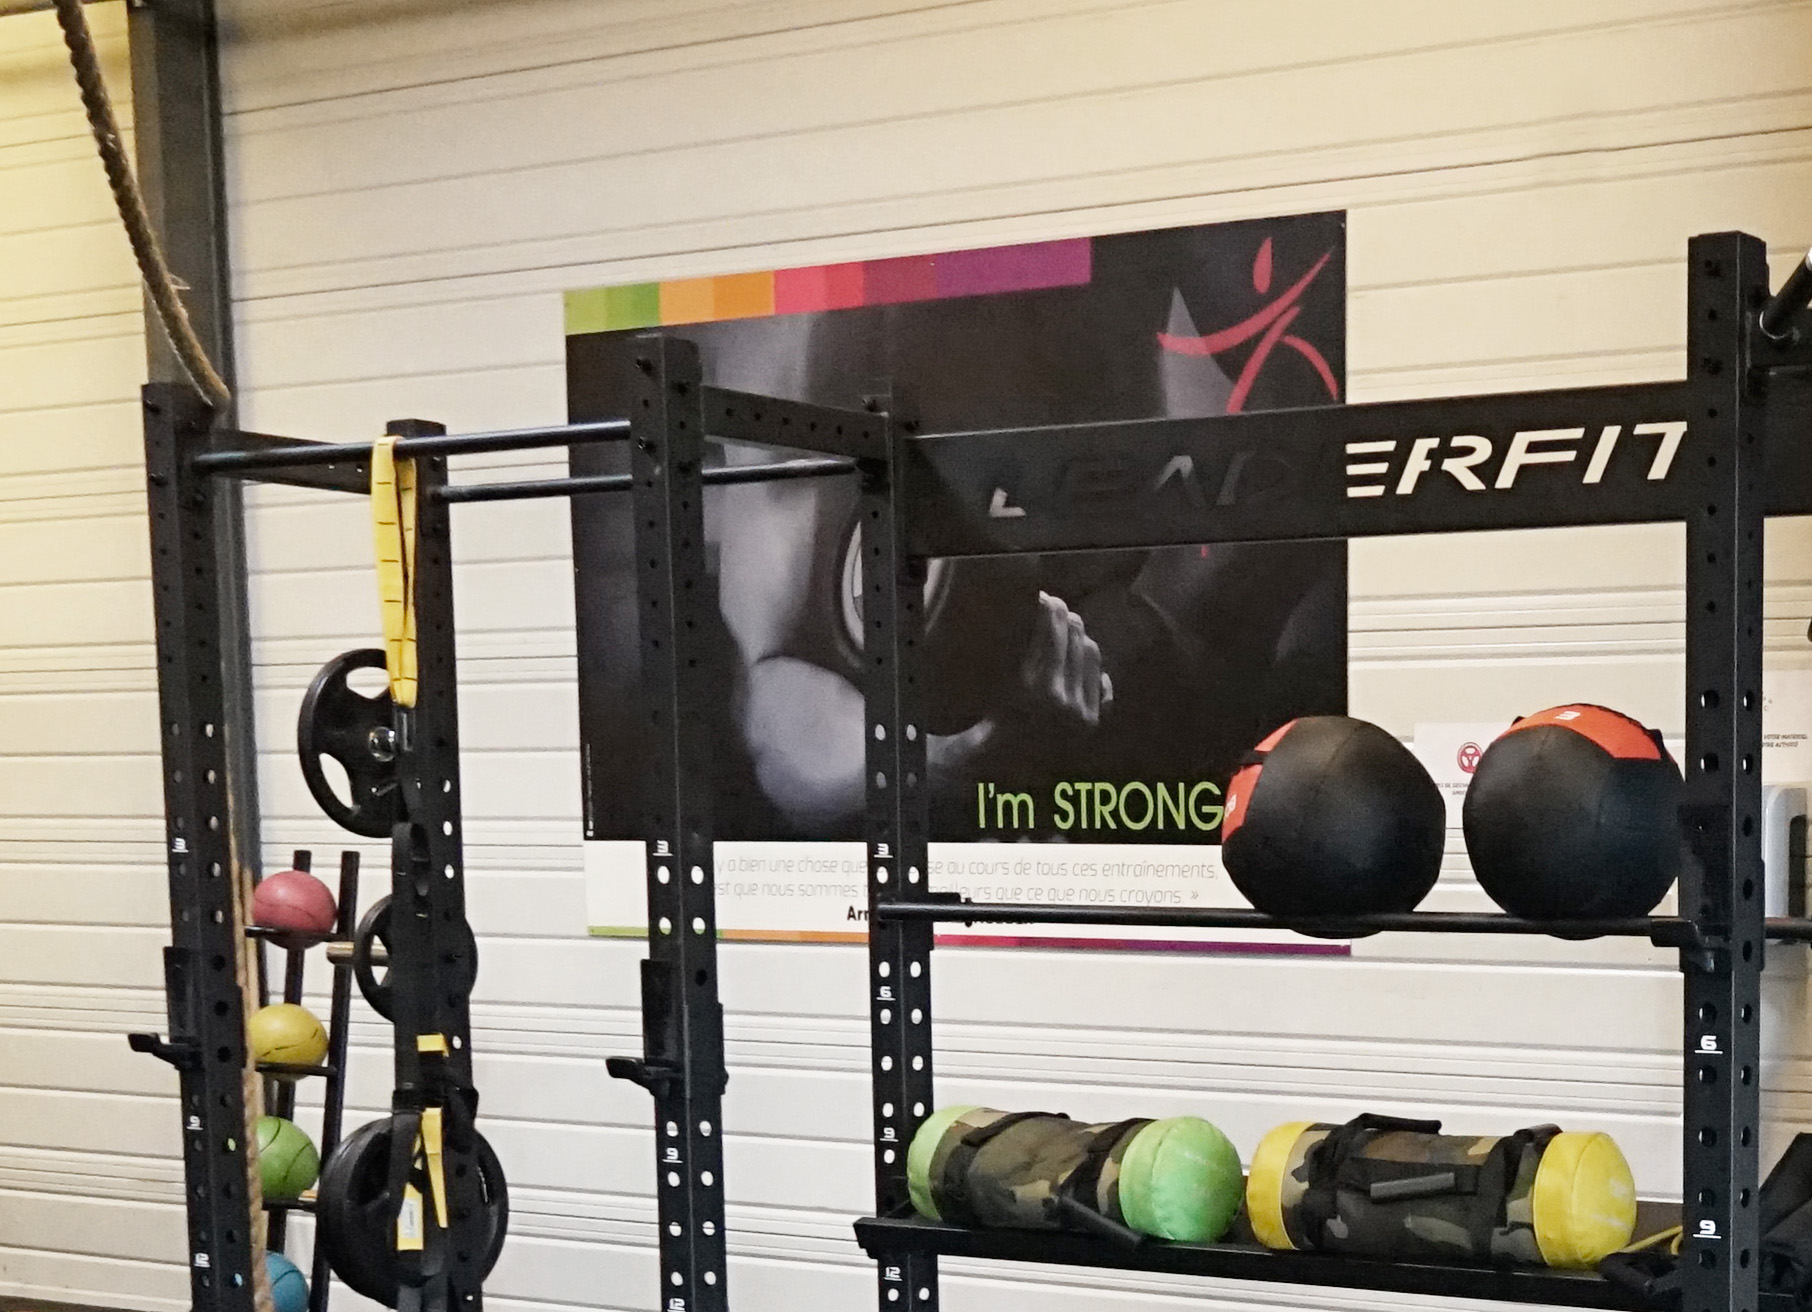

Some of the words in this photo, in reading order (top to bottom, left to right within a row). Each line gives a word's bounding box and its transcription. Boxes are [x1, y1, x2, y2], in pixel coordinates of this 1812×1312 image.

[1053, 781, 1224, 831] STRONG
[1701, 1035, 1717, 1050] 6
[1699, 1219, 1716, 1235] 9
